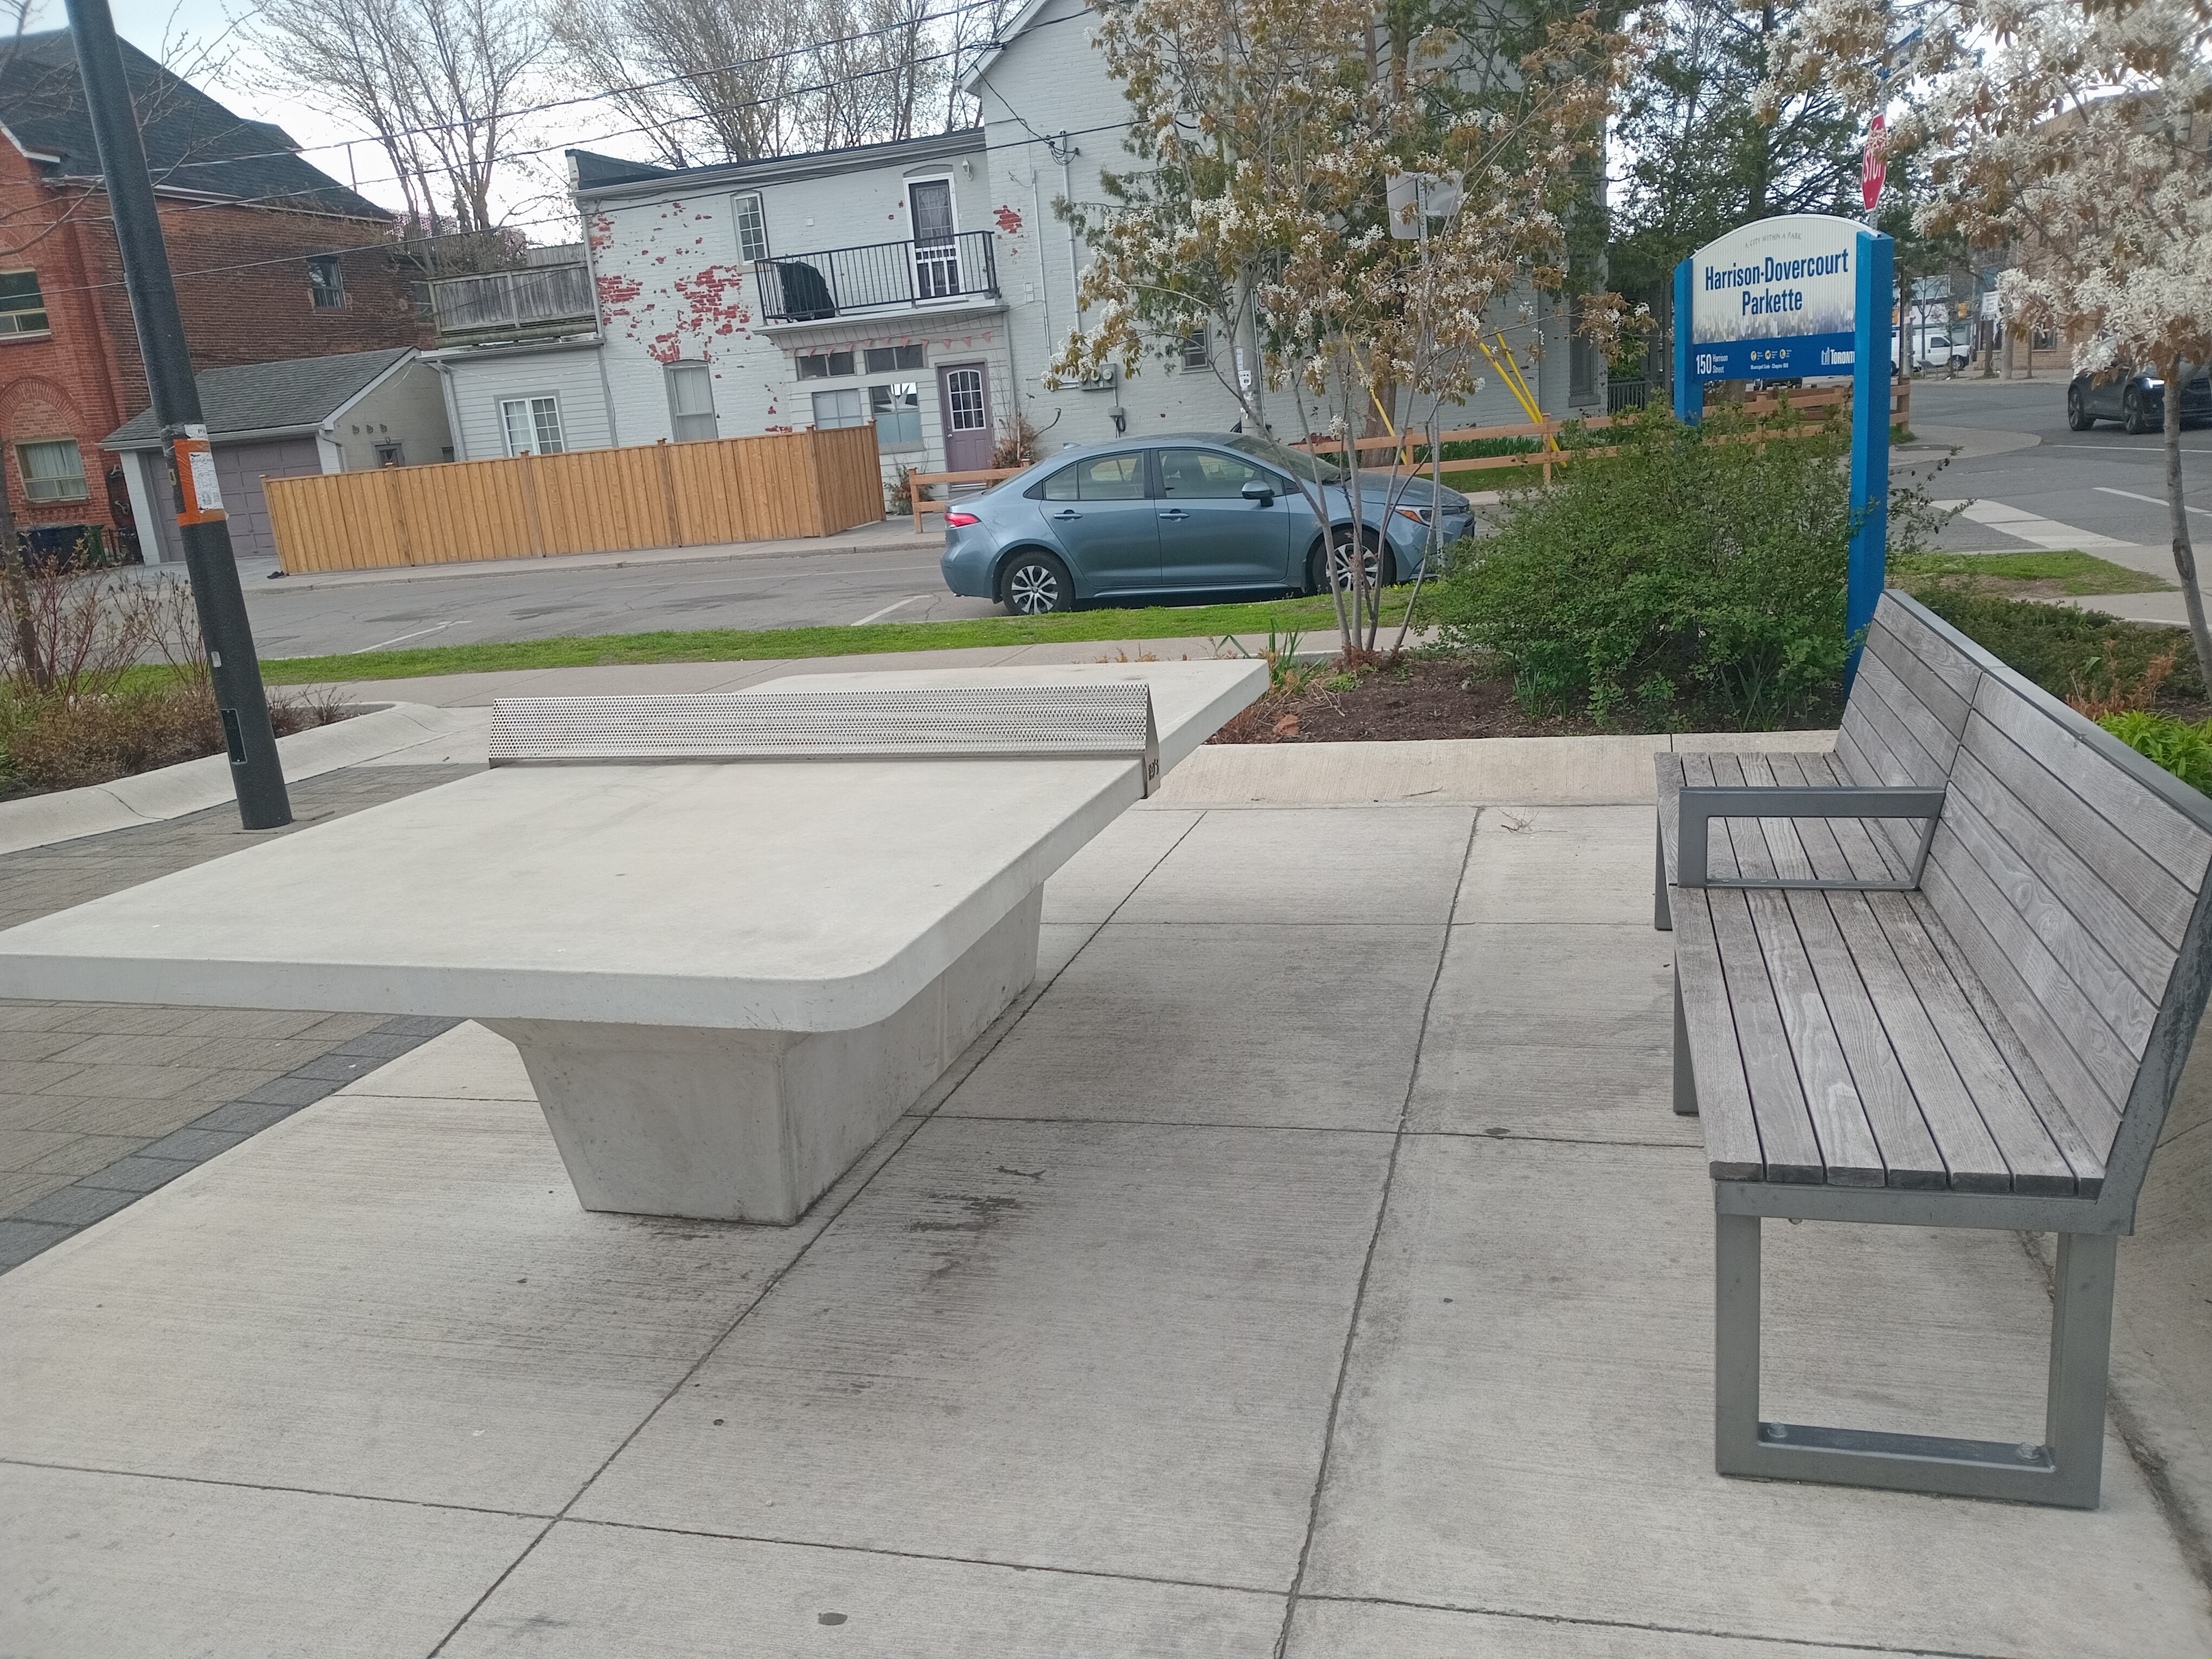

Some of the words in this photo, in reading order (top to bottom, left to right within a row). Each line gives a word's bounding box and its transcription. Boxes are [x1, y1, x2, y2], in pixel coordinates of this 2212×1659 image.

[1750, 237, 1761, 246] CITY
[1762, 233, 1780, 242] WITHIN
[1787, 232, 1802, 240] PARK
[1705, 248, 1849, 291] Harrison-Dovercourt
[1742, 288, 1803, 316] Parkette
[1696, 353, 1712, 375] 150
[1712, 353, 1728, 362] Harrison
[1712, 365, 1725, 374] Street
